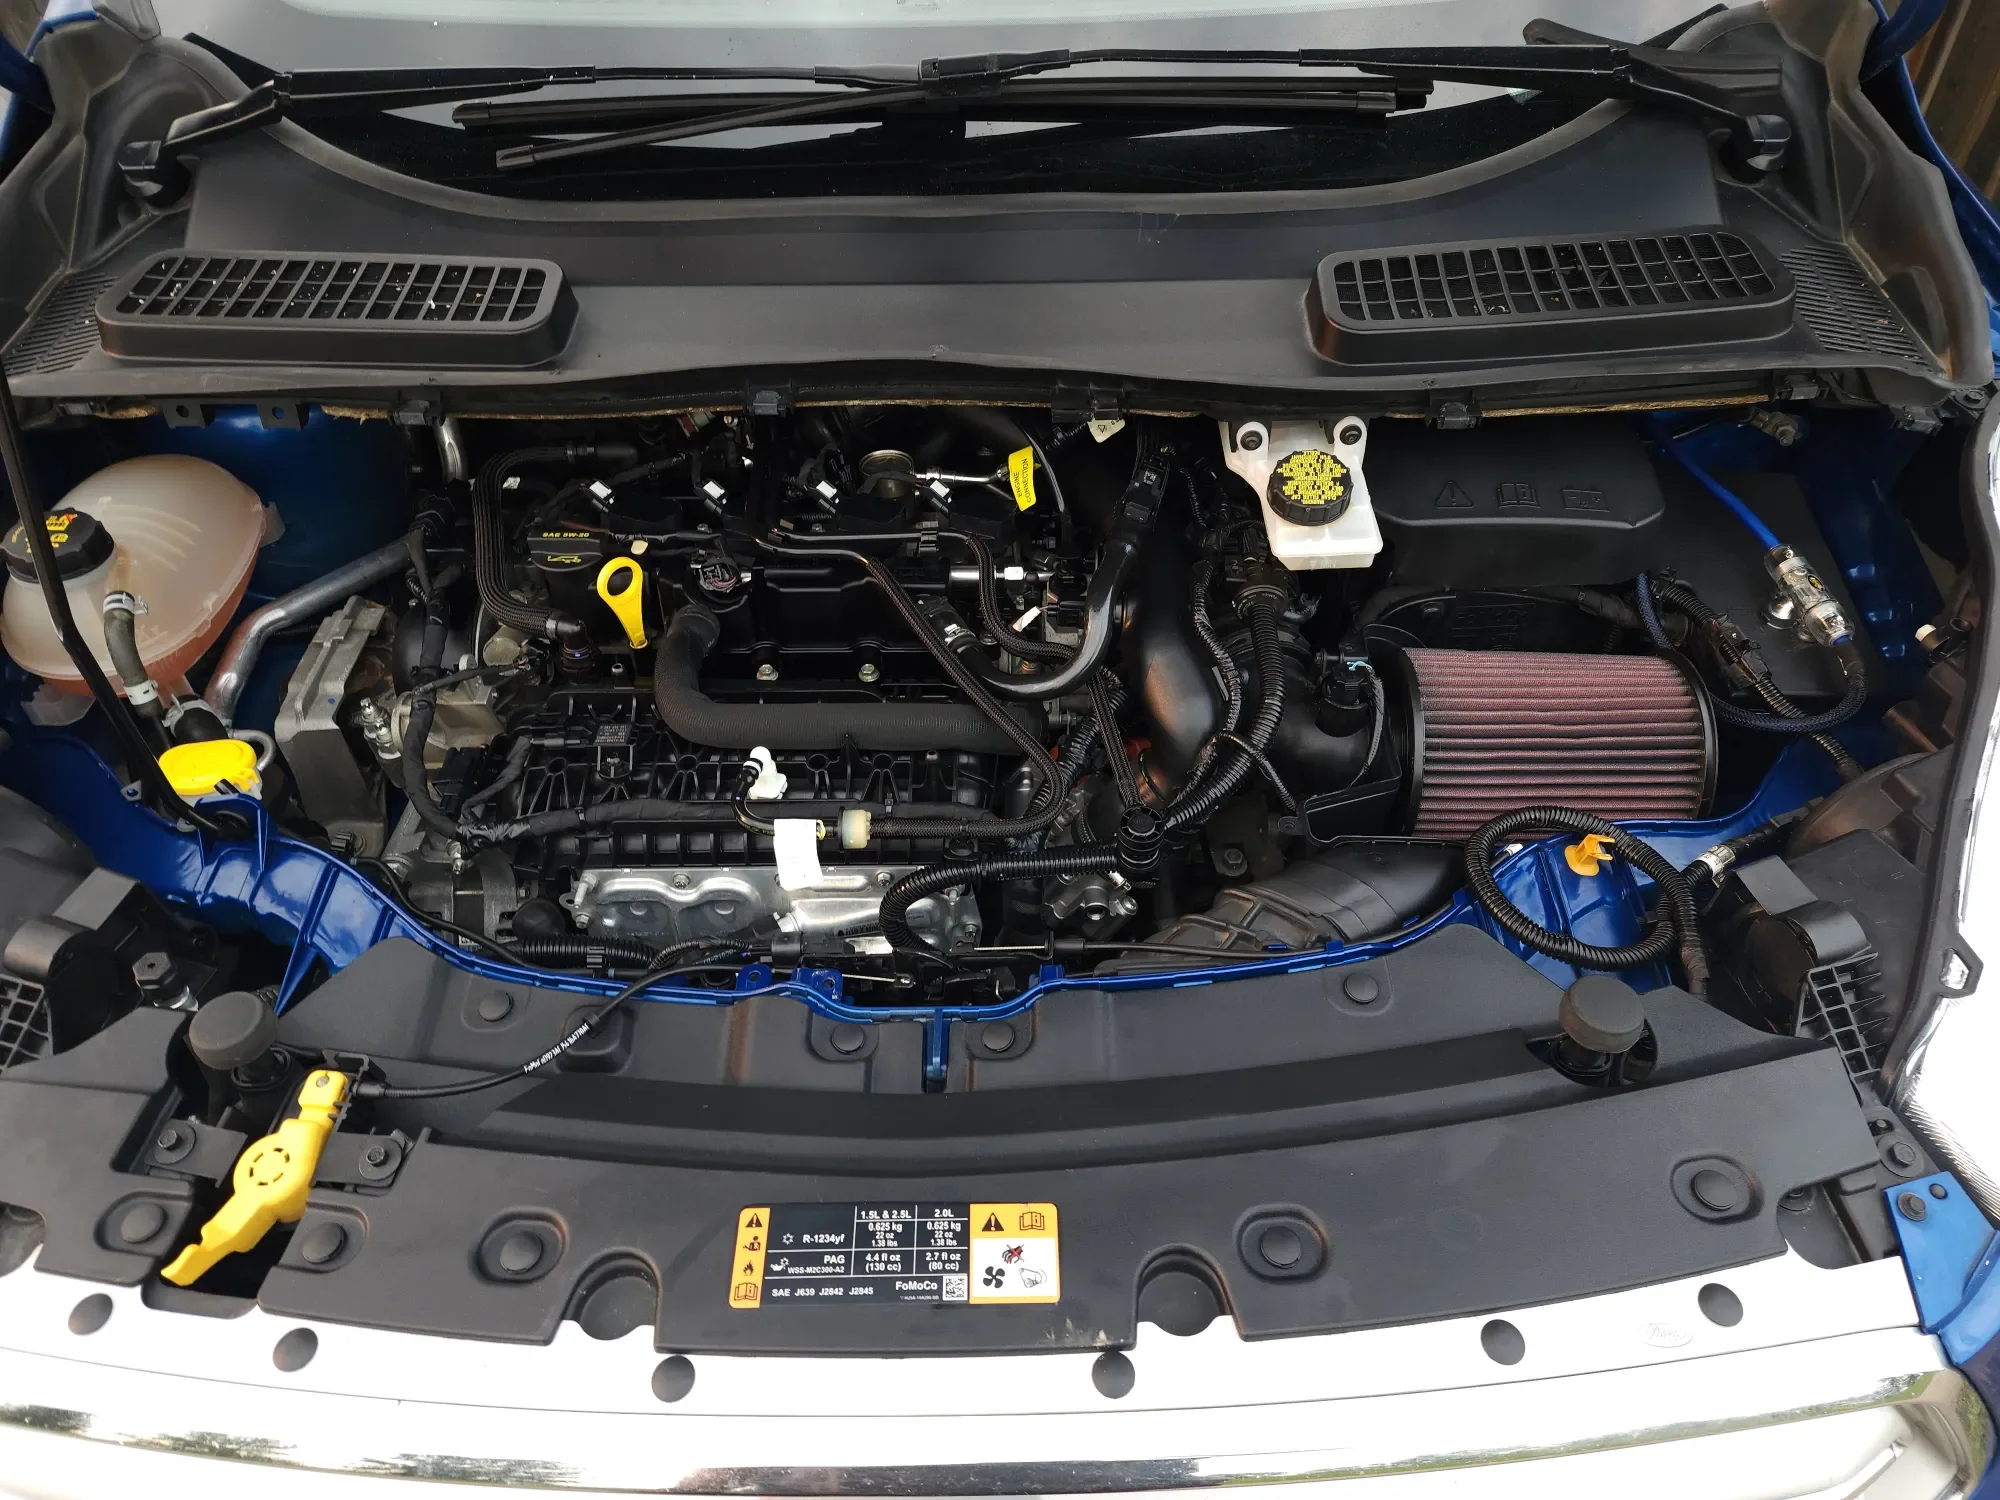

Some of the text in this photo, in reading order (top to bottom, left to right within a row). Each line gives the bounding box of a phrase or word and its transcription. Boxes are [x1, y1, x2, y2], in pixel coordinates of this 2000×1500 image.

[1013, 471, 1023, 498] ENGINE
[1021, 458, 1032, 503] CONNECTION
[861, 1210, 912, 1219] 1.5L & 2.5L
[934, 1209, 954, 1217] 2.0L
[868, 1222, 903, 1232] 0.625 kg
[927, 1222, 961, 1232] 0.625 kg
[802, 1234, 845, 1244] R-1234yf
[824, 1255, 845, 1264] PAG
[865, 1253, 879, 1261] 4.4
[881, 1253, 888, 1261] fl
[926, 1252, 939, 1260] 2.7
[941, 1252, 948, 1260] fl
[788, 1266, 845, 1274] WSS-M2C300-A2
[865, 1262, 901, 1273] (130 cc)
[929, 1261, 959, 1271] (80 cc)
[896, 1281, 938, 1290] FoMoCo
[772, 1287, 874, 1297] SAE J639 J2842 J2845
